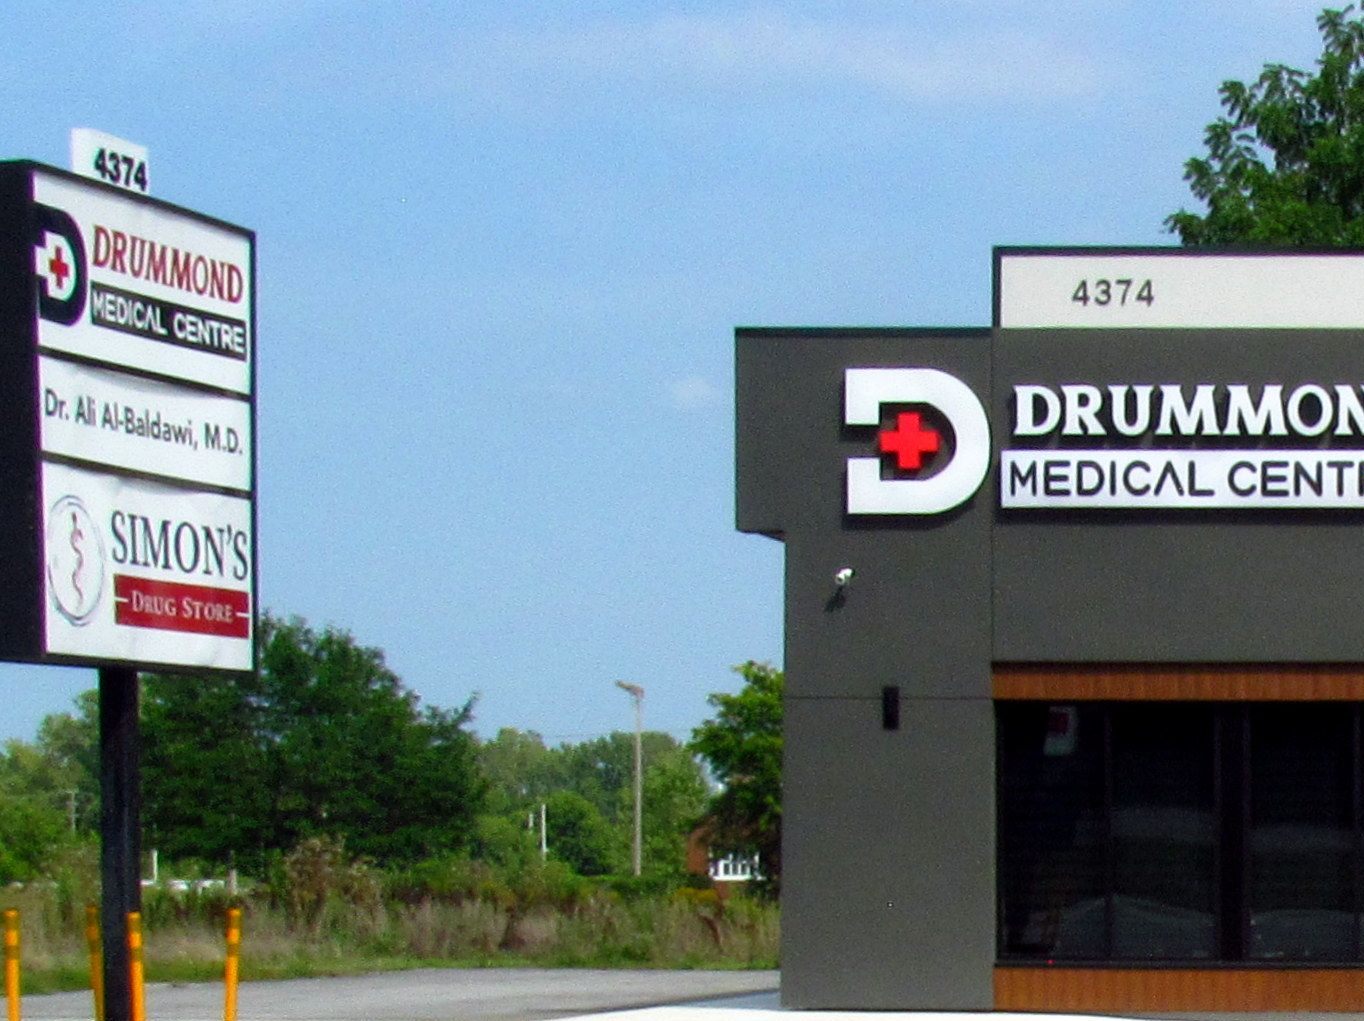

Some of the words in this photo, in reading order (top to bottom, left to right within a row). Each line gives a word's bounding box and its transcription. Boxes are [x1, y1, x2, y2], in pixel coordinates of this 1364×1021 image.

[94, 148, 147, 191] 4374
[93, 224, 243, 303] DRUMMOND
[1072, 279, 1155, 306] 4374
[93, 291, 168, 335] MEDICAL
[174, 312, 245, 353] CENTRE
[45, 388, 69, 420] Dr.
[75, 396, 96, 426] Ali
[102, 403, 199, 450] Al-Baldawi,
[205, 422, 243, 454] M.D.
[1010, 460, 1214, 497] MEDICAL
[111, 511, 249, 580] SIMON'S
